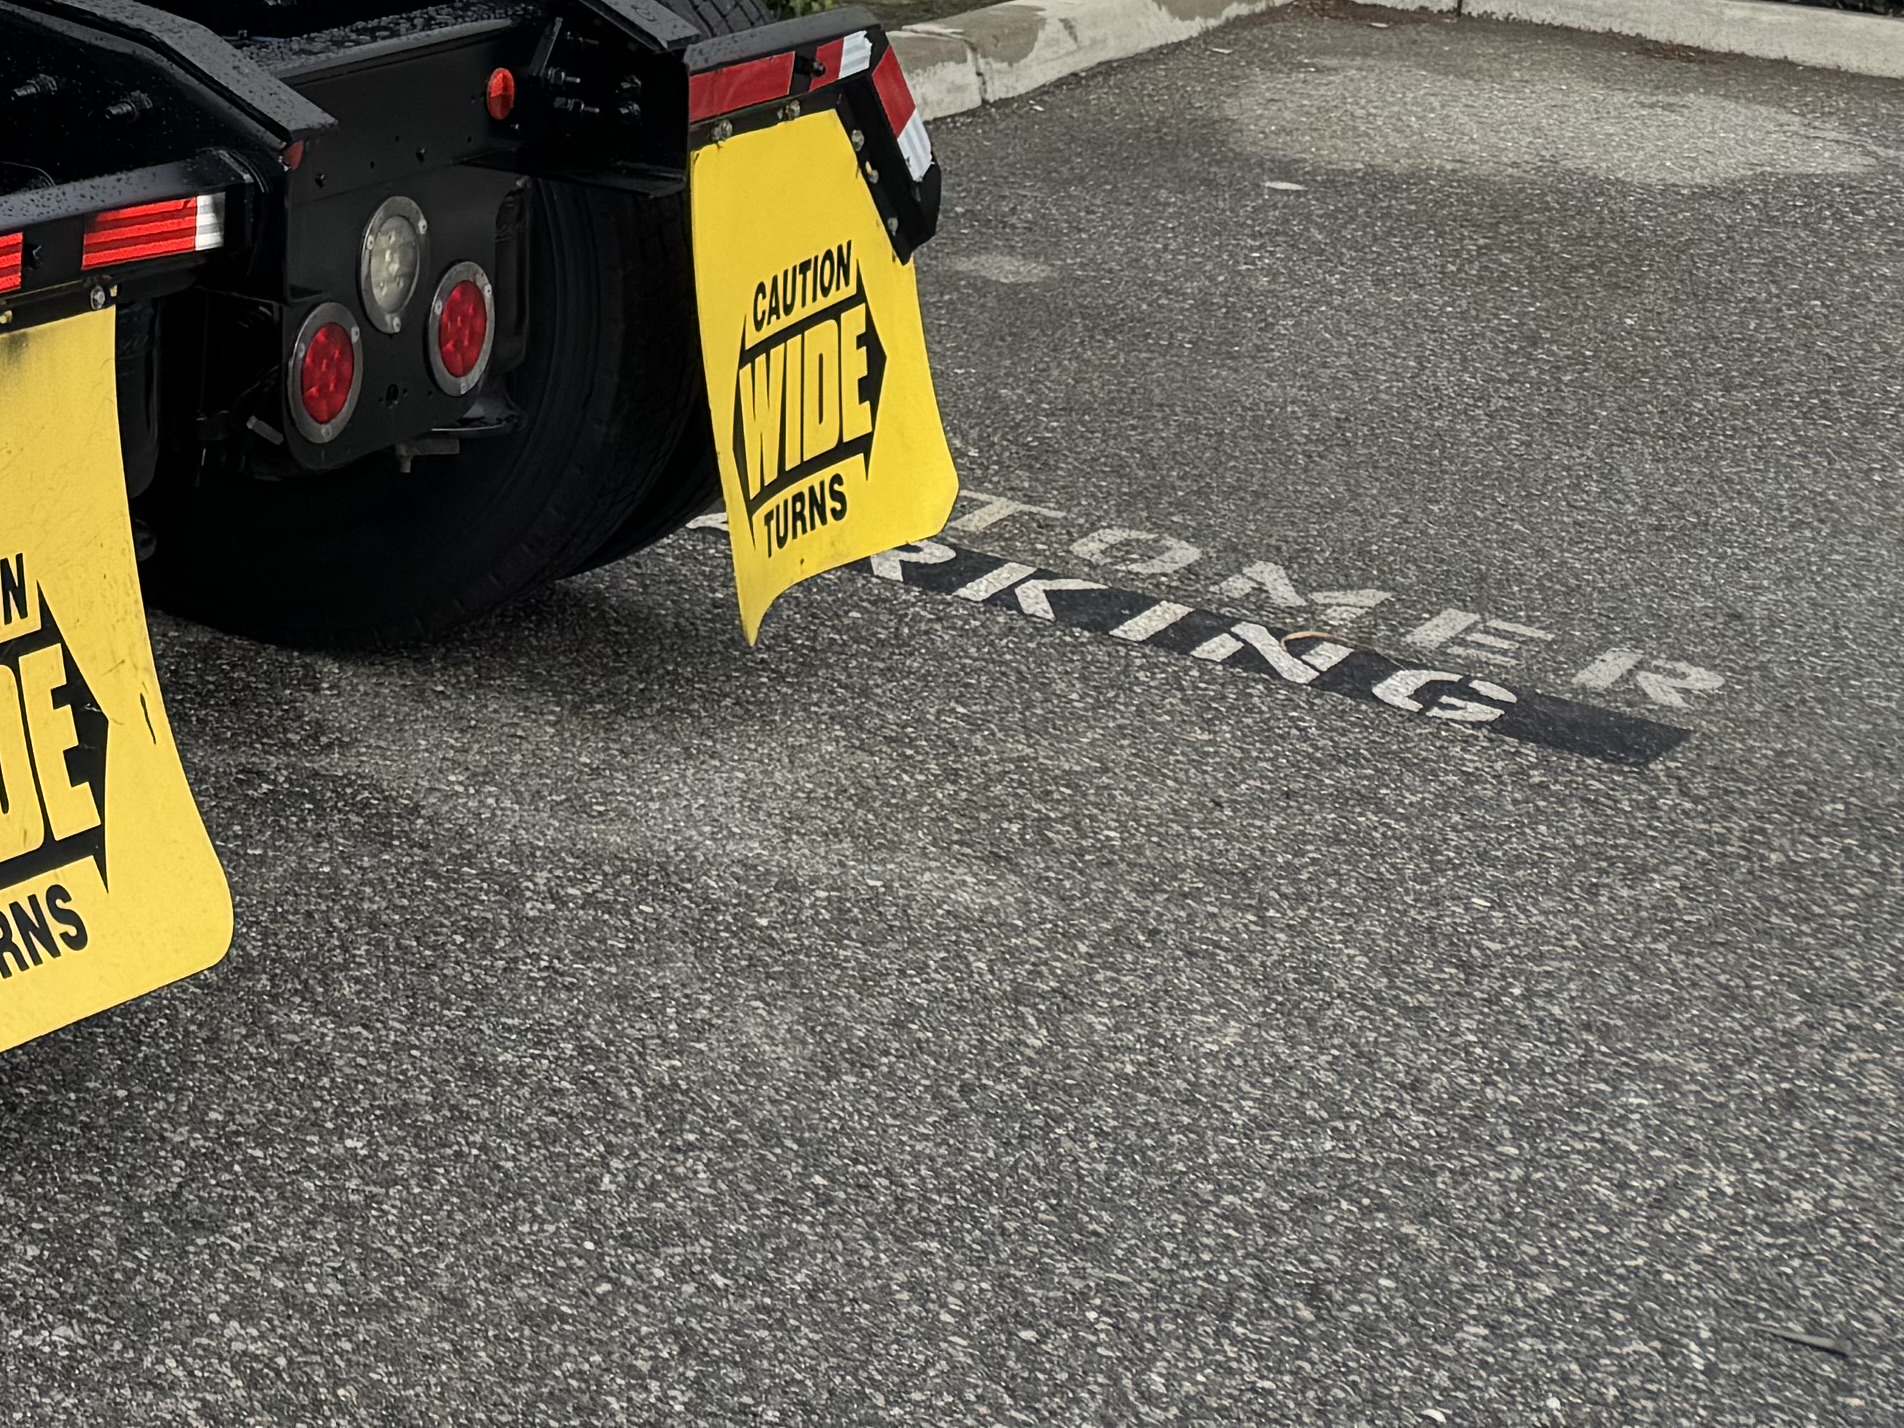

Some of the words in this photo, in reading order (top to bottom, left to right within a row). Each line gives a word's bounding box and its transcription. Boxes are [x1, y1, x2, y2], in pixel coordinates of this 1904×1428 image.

[752, 239, 853, 332] CAUTION
[738, 302, 874, 501] WIDE
[763, 472, 849, 560] TURNS
[952, 489, 1726, 710] TOMER
[868, 540, 1518, 724] RKING
